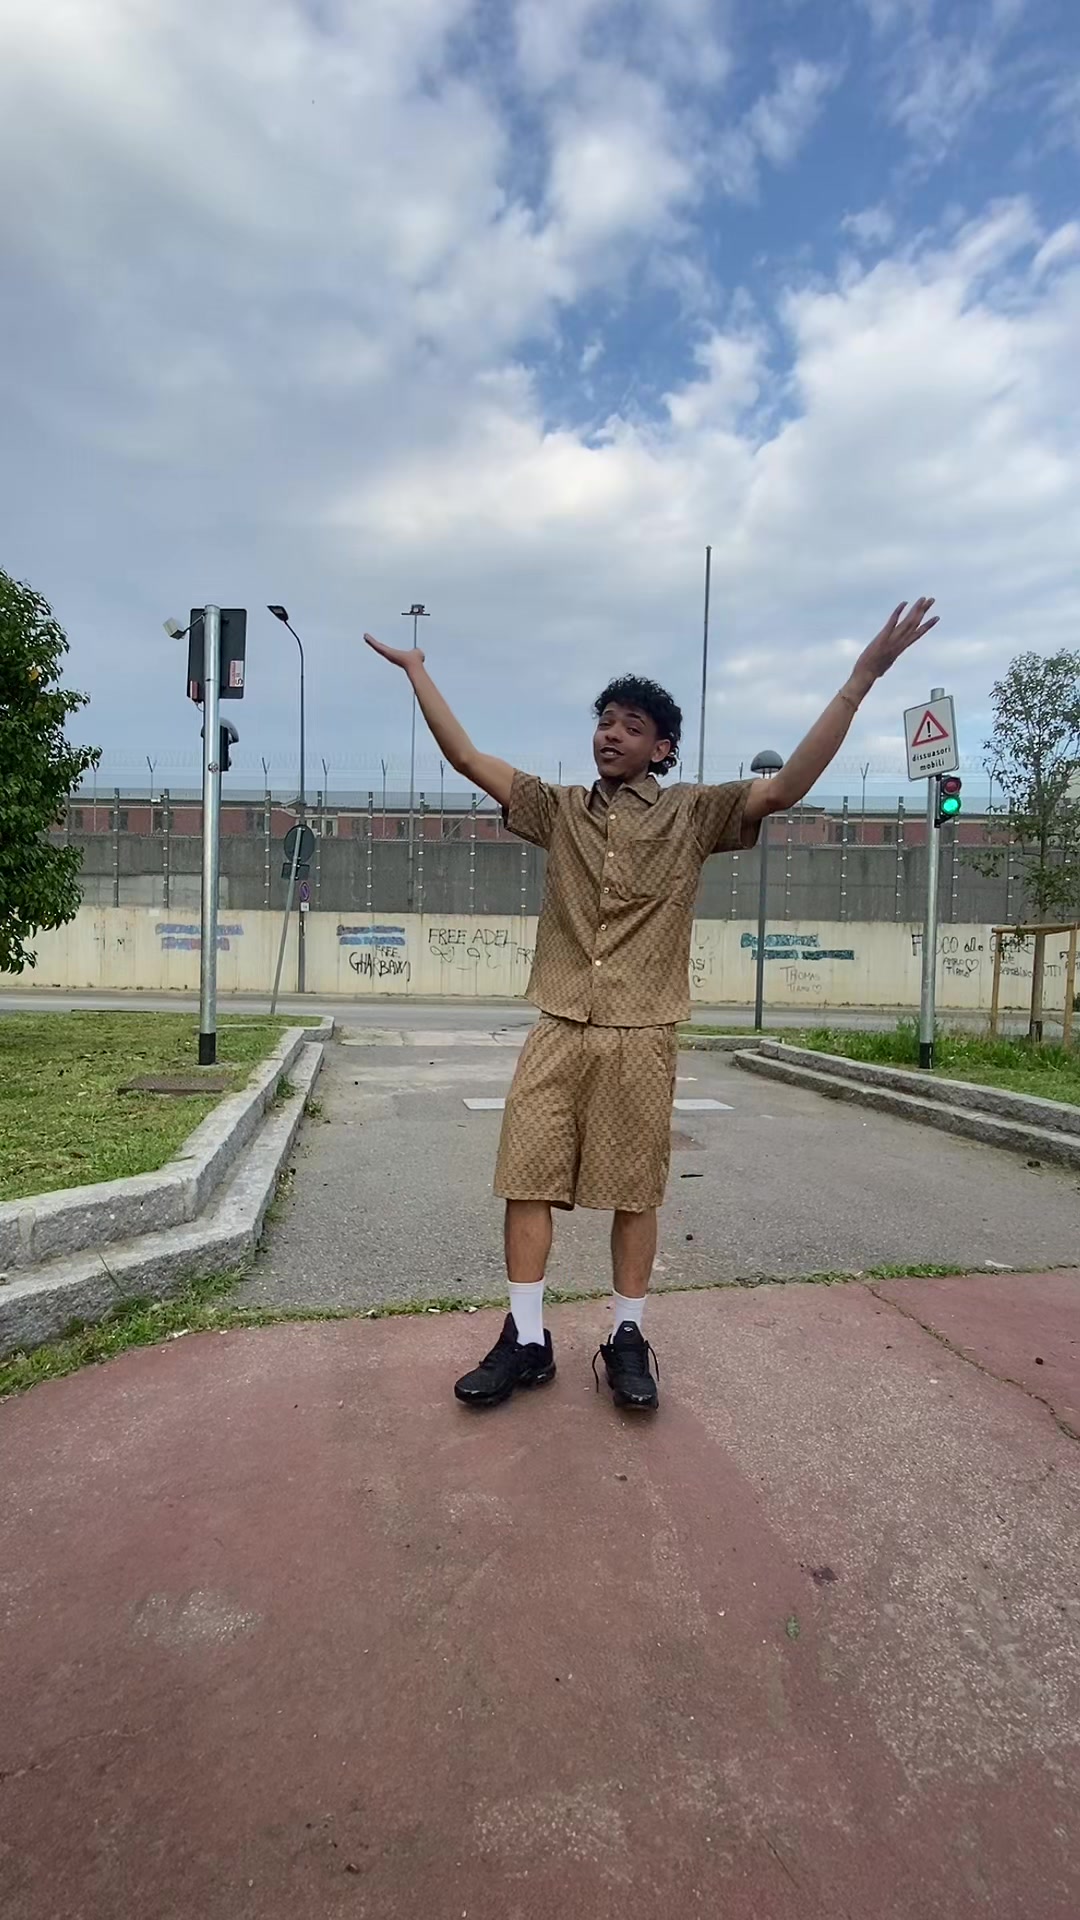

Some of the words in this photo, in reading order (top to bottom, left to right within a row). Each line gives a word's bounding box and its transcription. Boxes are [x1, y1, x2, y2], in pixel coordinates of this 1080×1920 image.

[912, 745, 951, 762] dissuasori
[920, 758, 945, 771] mobili
[428, 928, 467, 945] FREE
[471, 928, 517, 948] ADEL
